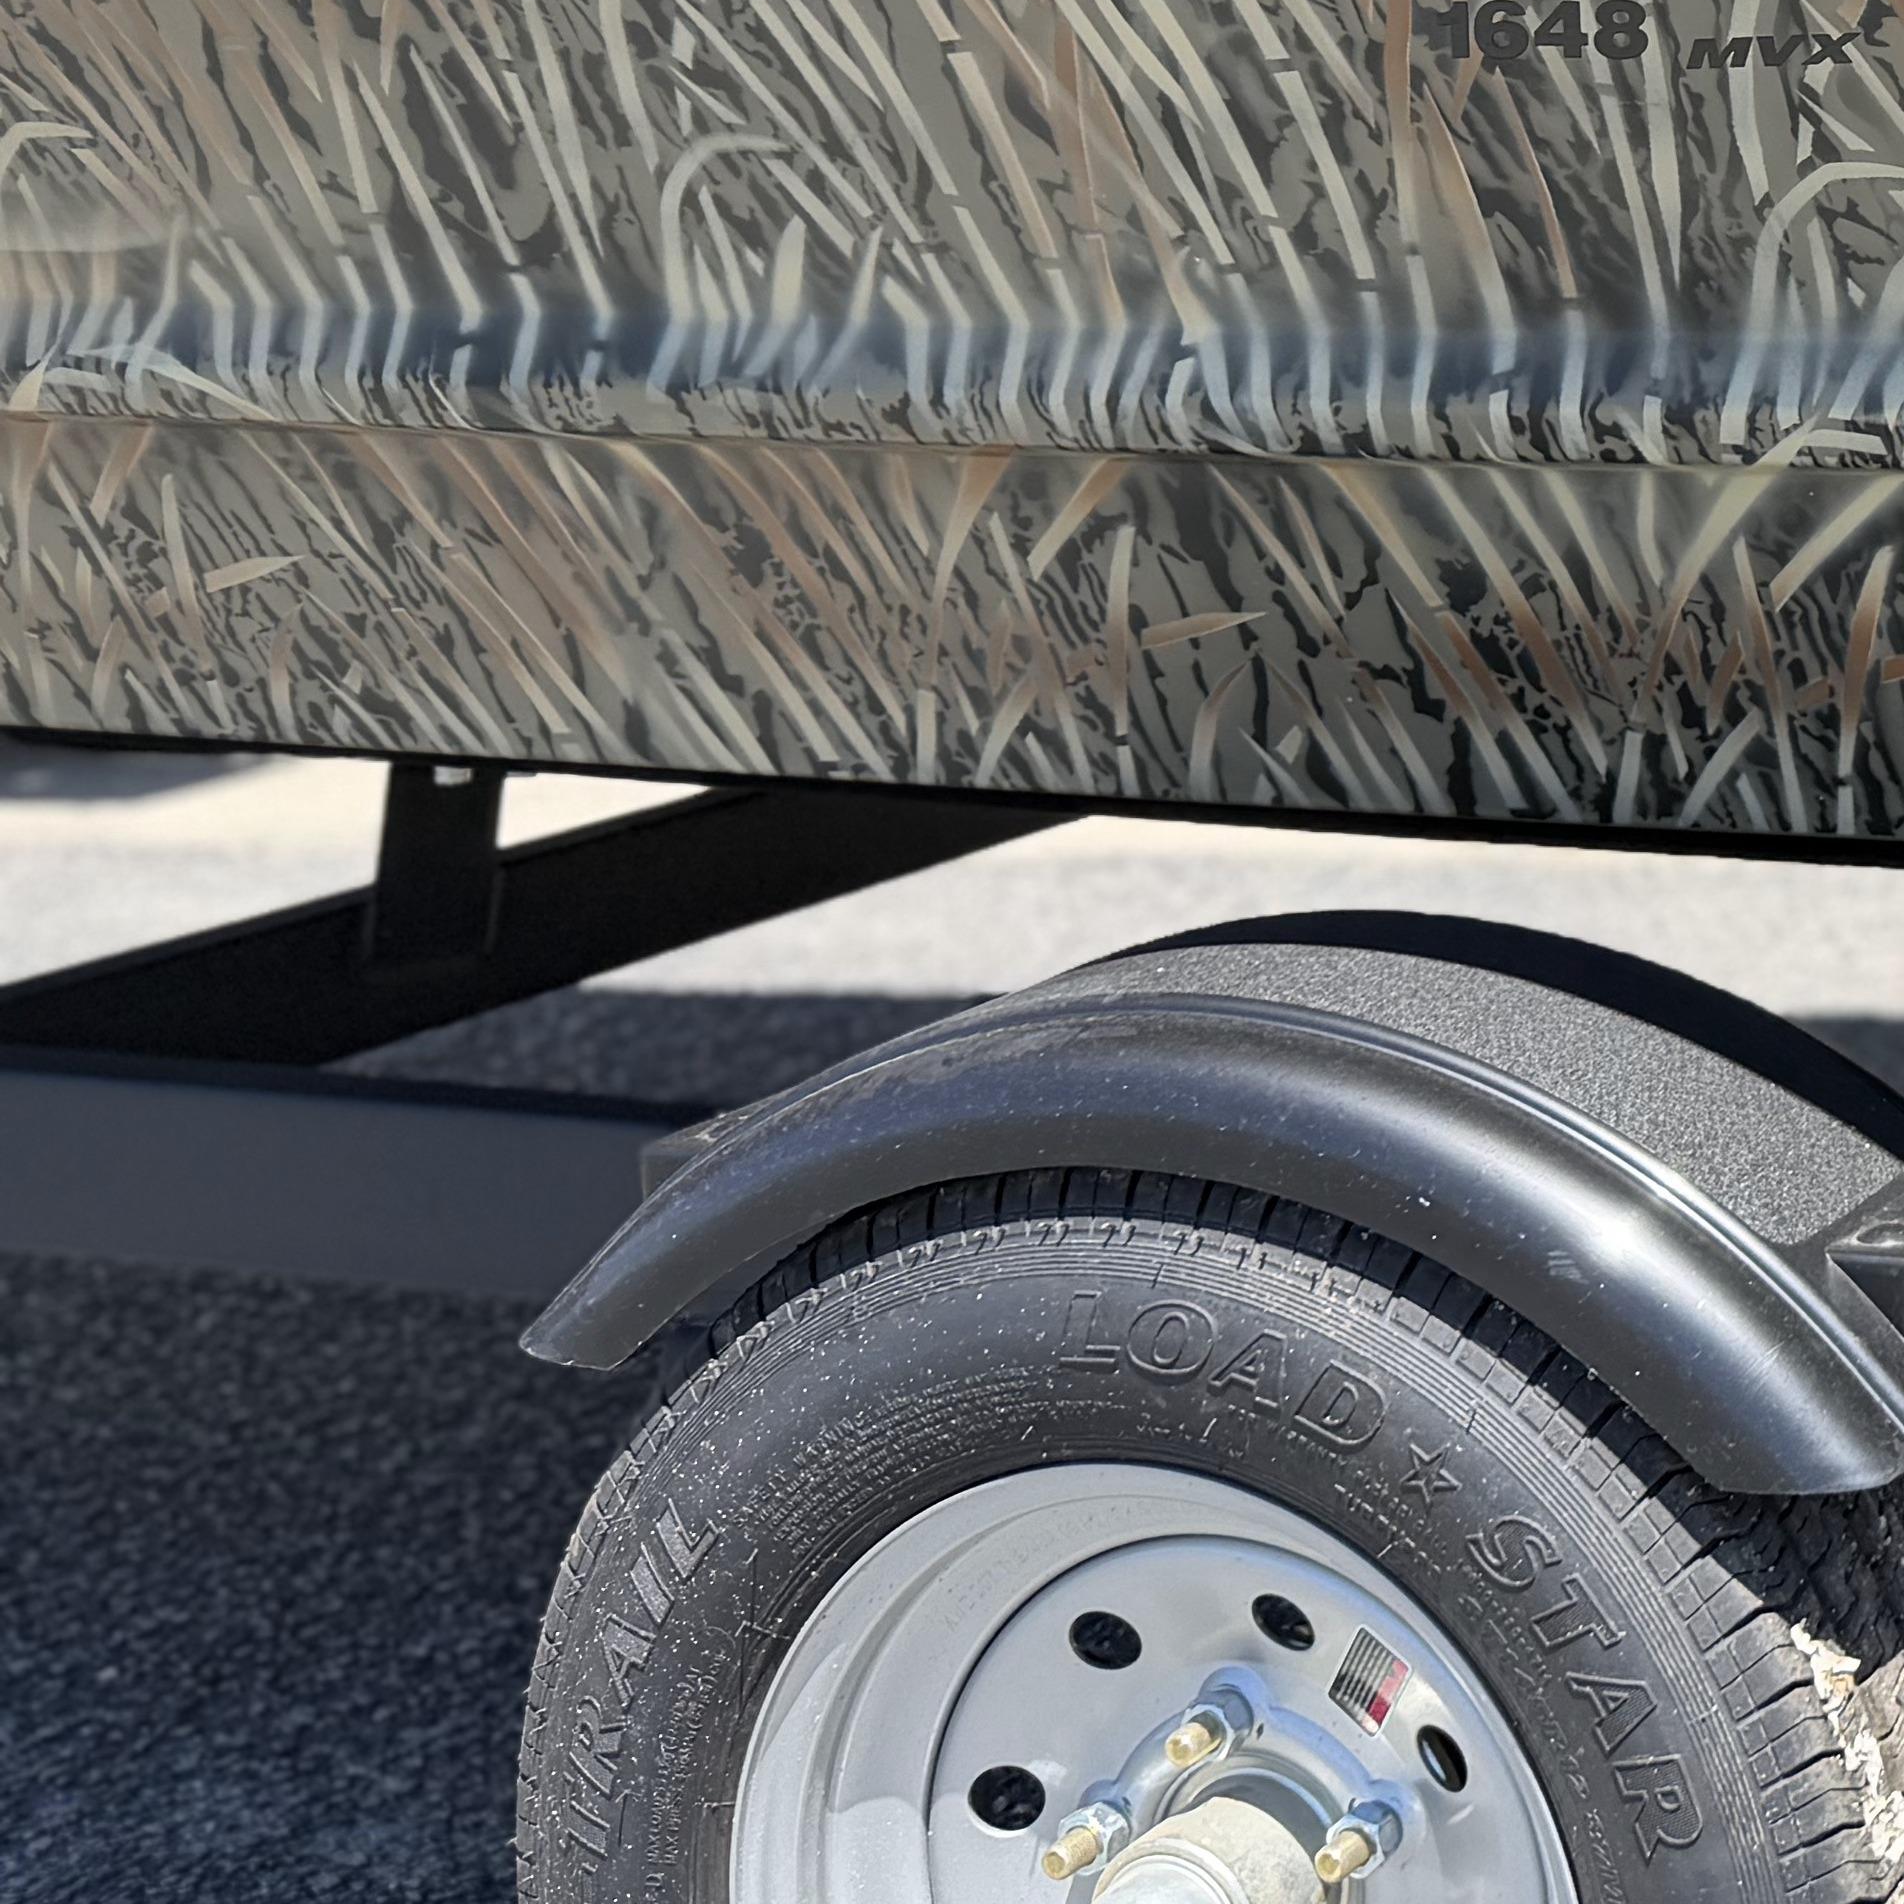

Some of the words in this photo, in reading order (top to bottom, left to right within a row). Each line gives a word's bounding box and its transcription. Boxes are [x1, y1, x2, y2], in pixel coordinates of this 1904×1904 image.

[1437, 0, 1650, 61] 1648
[1686, 32, 1861, 70] MVX
[560, 1497, 721, 1862] TRAIL
[1059, 1289, 1388, 1448] LOAD
[1465, 1513, 1704, 1866] STAR
